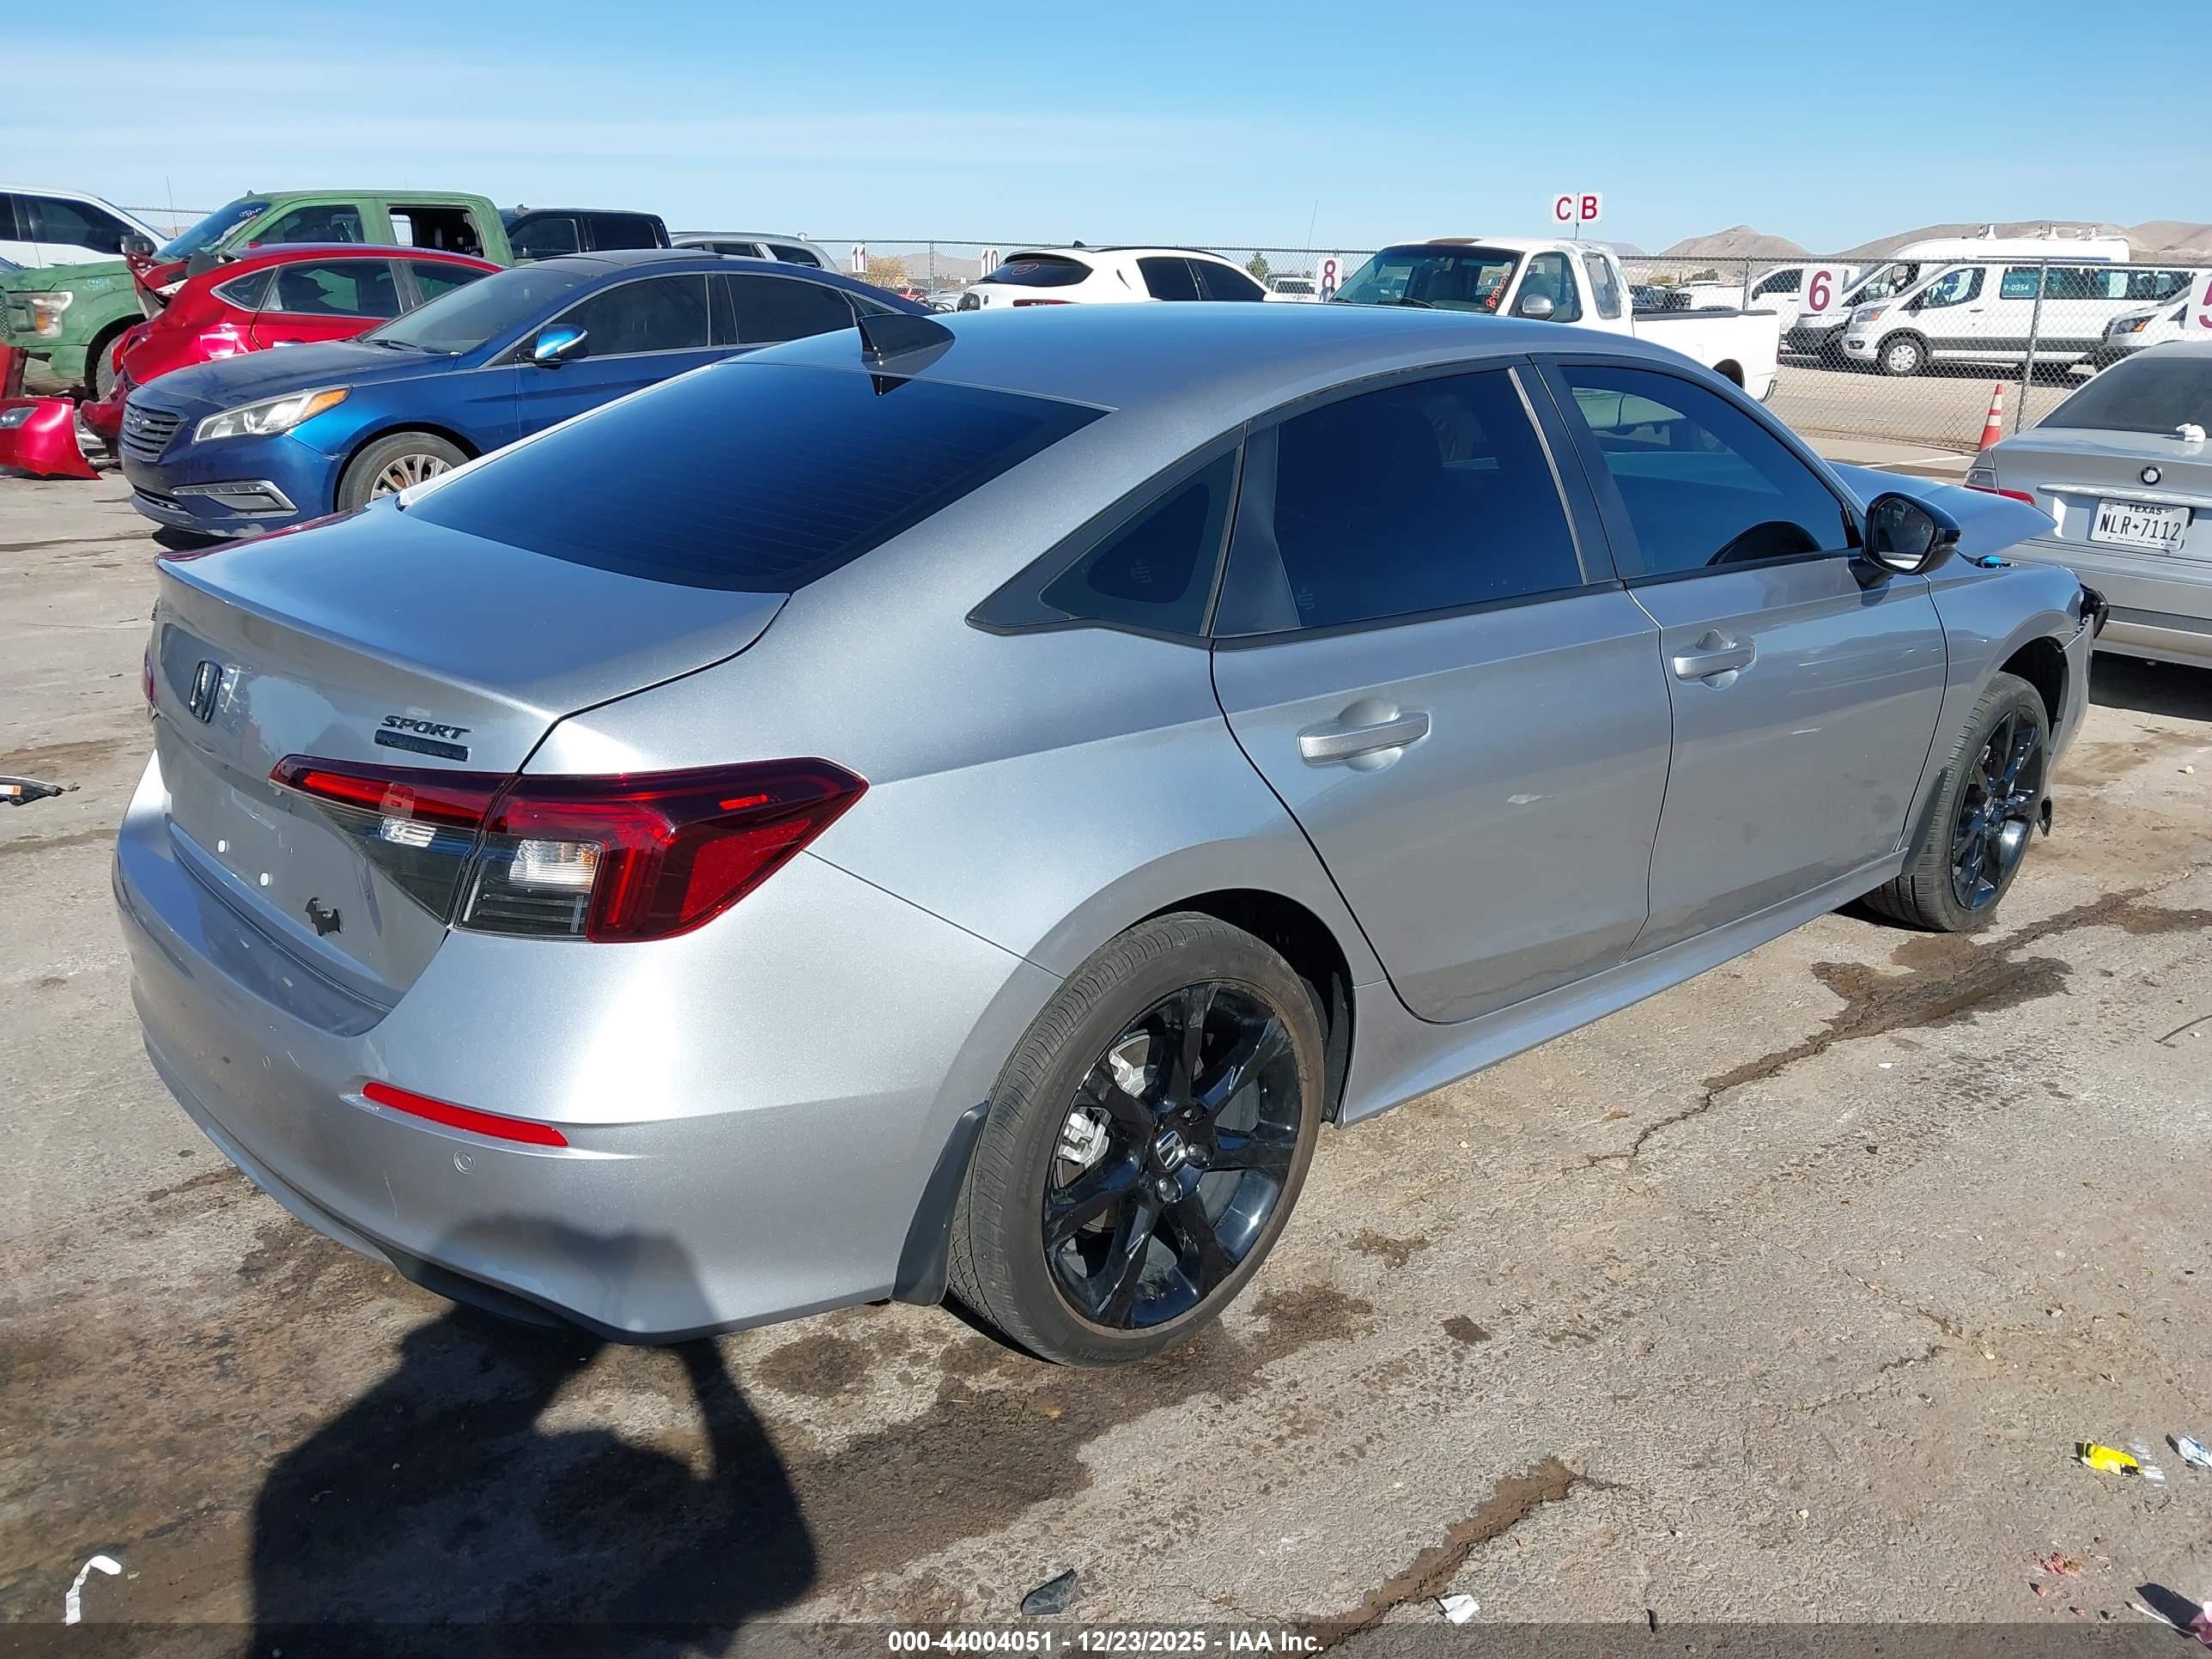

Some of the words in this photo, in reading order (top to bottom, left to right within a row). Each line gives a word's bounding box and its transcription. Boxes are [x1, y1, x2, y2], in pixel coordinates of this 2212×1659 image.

[1556, 196, 1572, 221] C
[1581, 196, 1597, 220] B
[853, 246, 866, 272] 11
[982, 249, 999, 276] 10
[1322, 259, 1336, 289] 8
[1808, 270, 1832, 311] 6
[2128, 504, 2162, 515] TEXAS
[380, 715, 473, 739] SPORT
